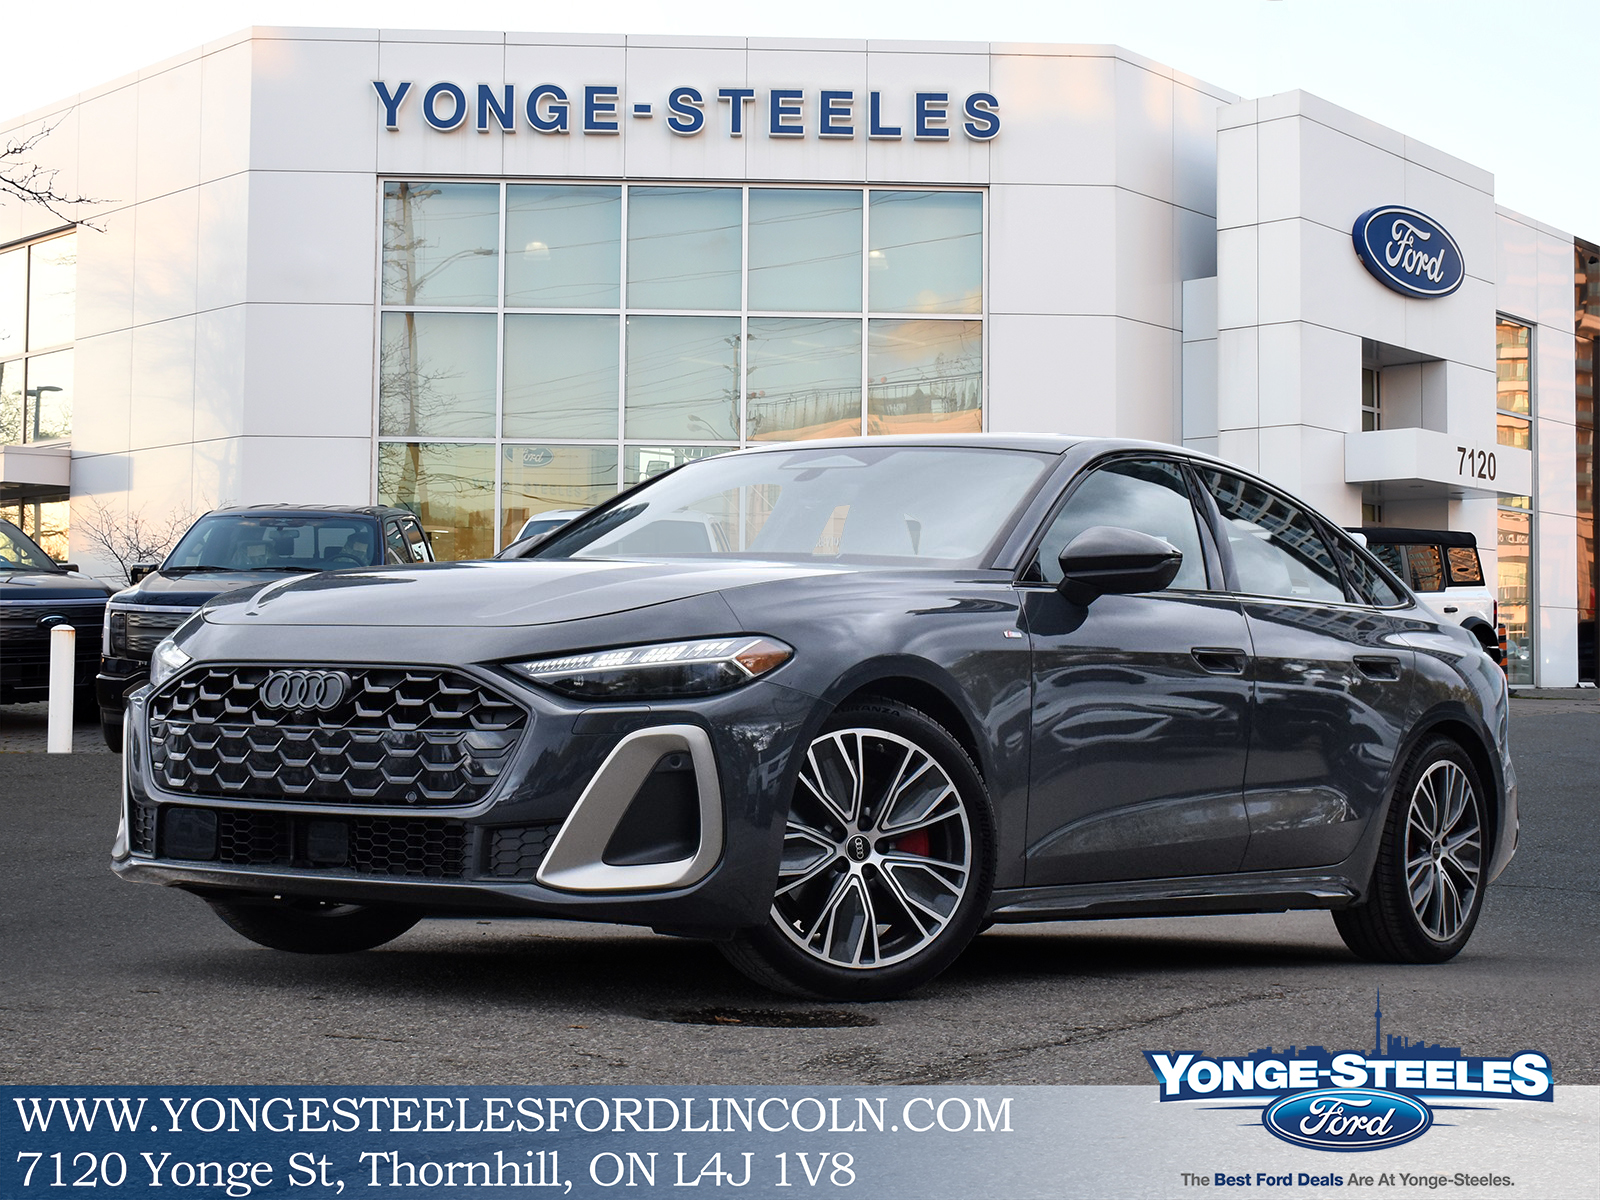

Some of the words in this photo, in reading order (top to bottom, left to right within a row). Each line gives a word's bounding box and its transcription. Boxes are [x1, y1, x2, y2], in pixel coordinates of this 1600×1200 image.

[372, 80, 1002, 139] YONGE-STEELES
[1385, 219, 1445, 283] Ford
[1456, 446, 1497, 481] 7120
